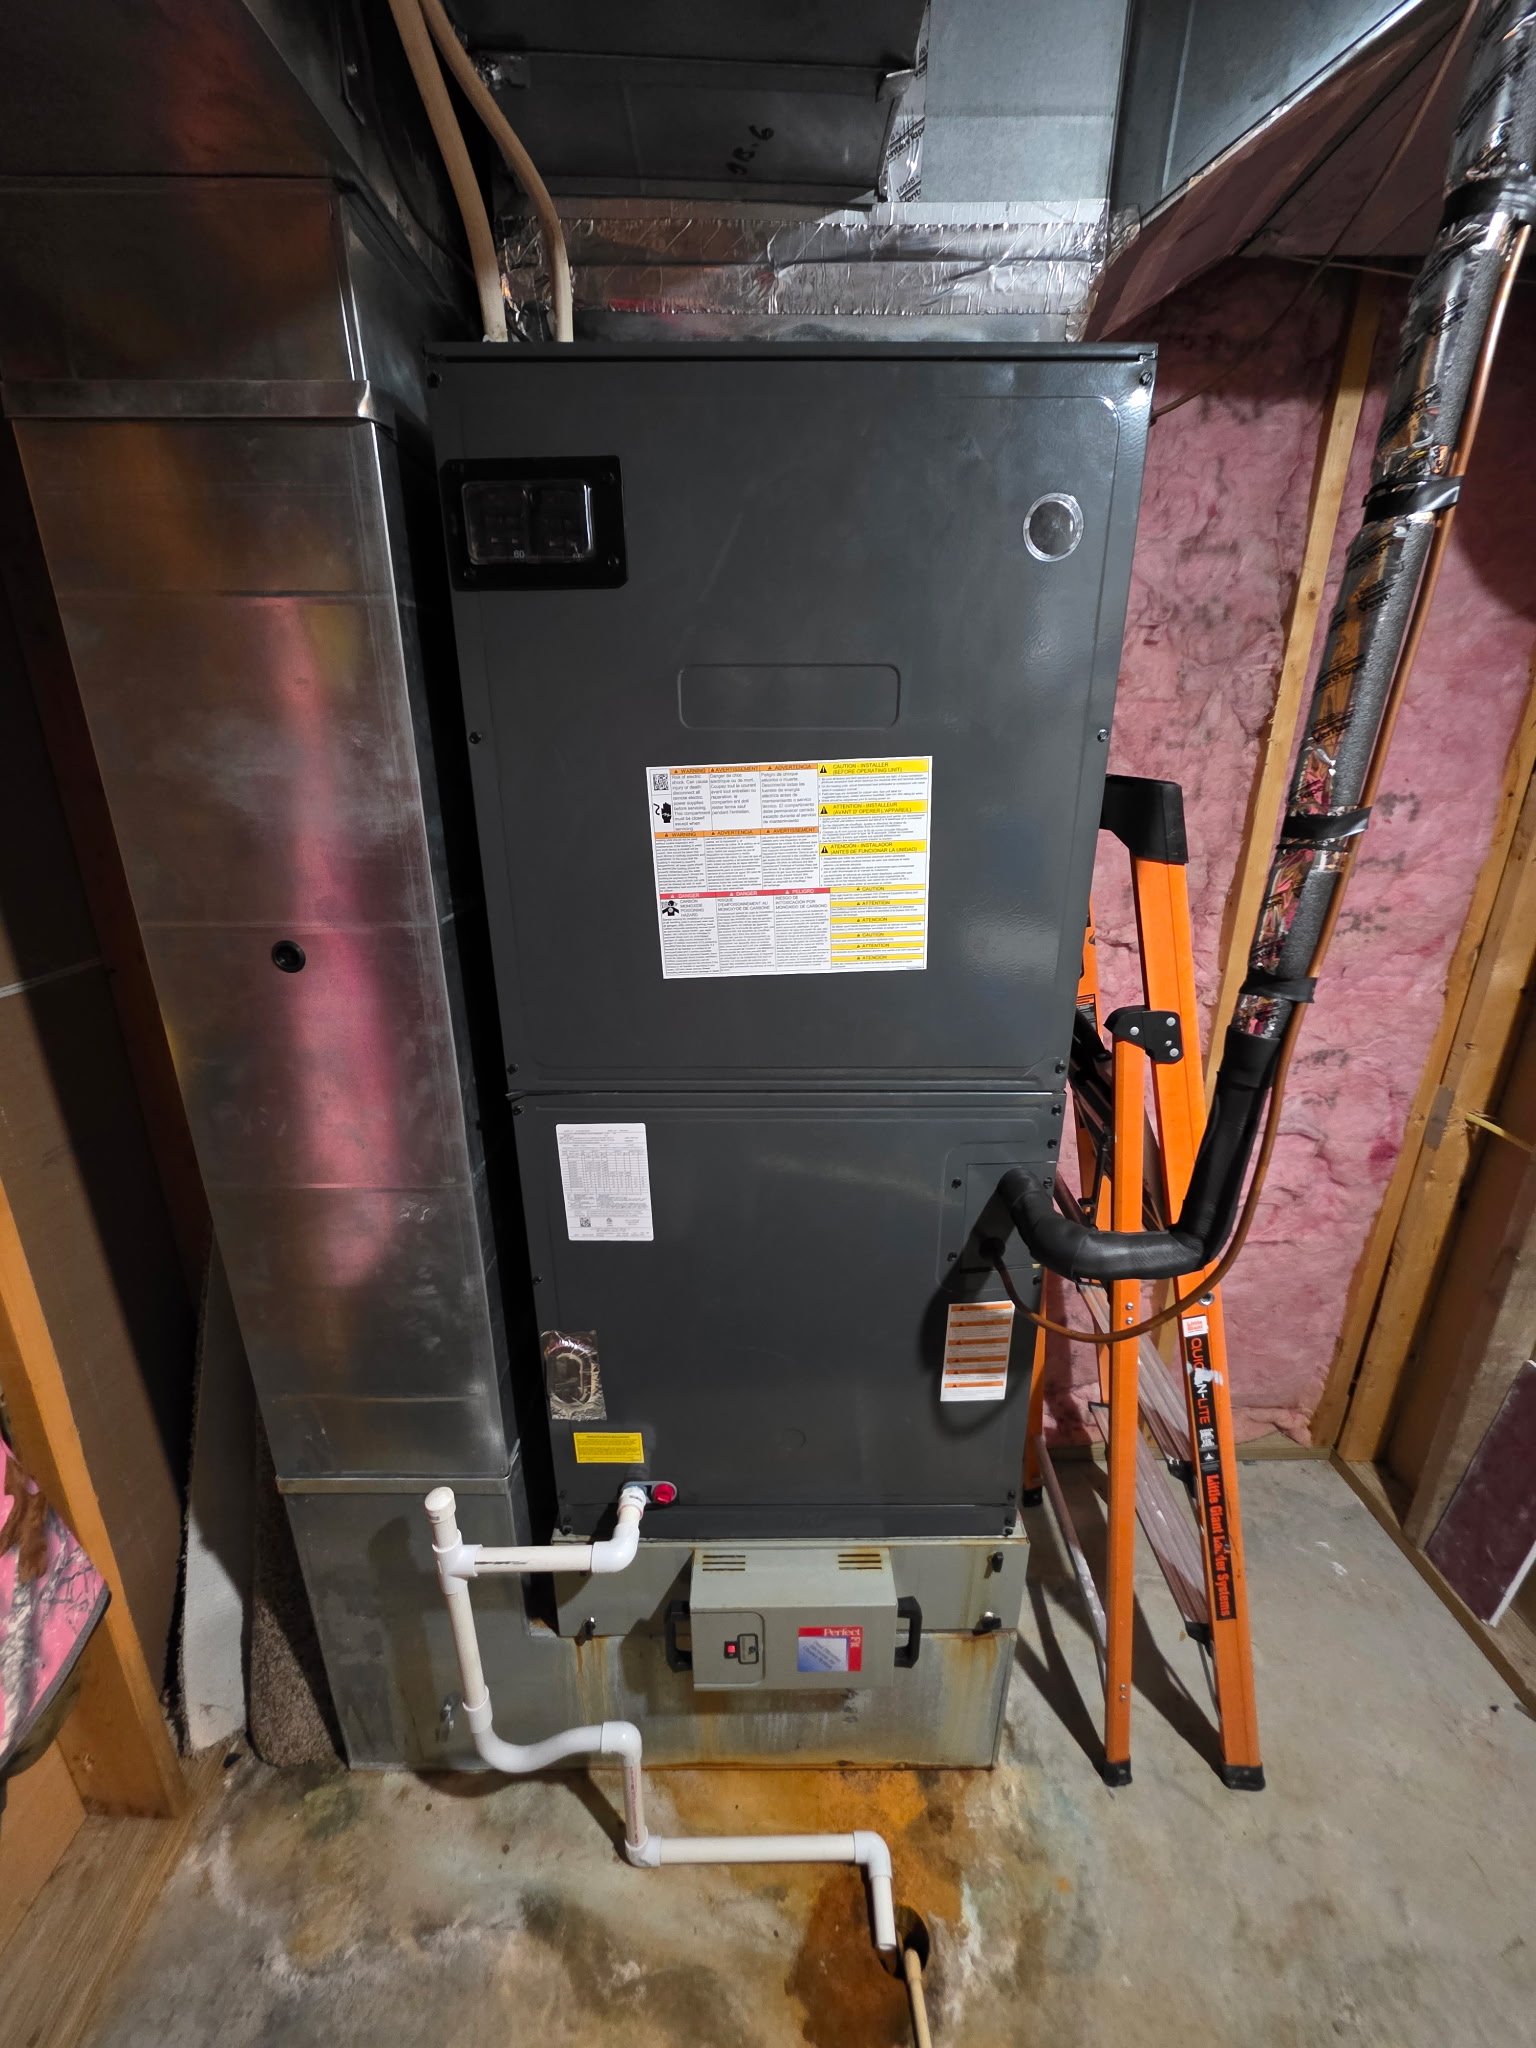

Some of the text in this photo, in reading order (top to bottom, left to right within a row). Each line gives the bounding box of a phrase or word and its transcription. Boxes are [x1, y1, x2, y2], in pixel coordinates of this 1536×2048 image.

[1206, 1474, 1221, 1503] Little
[1209, 1505, 1224, 1533] Giant
[1215, 1573, 1230, 1616] Systems
[824, 1628, 860, 1636] Perfect
[850, 1636, 860, 1648] Fit
